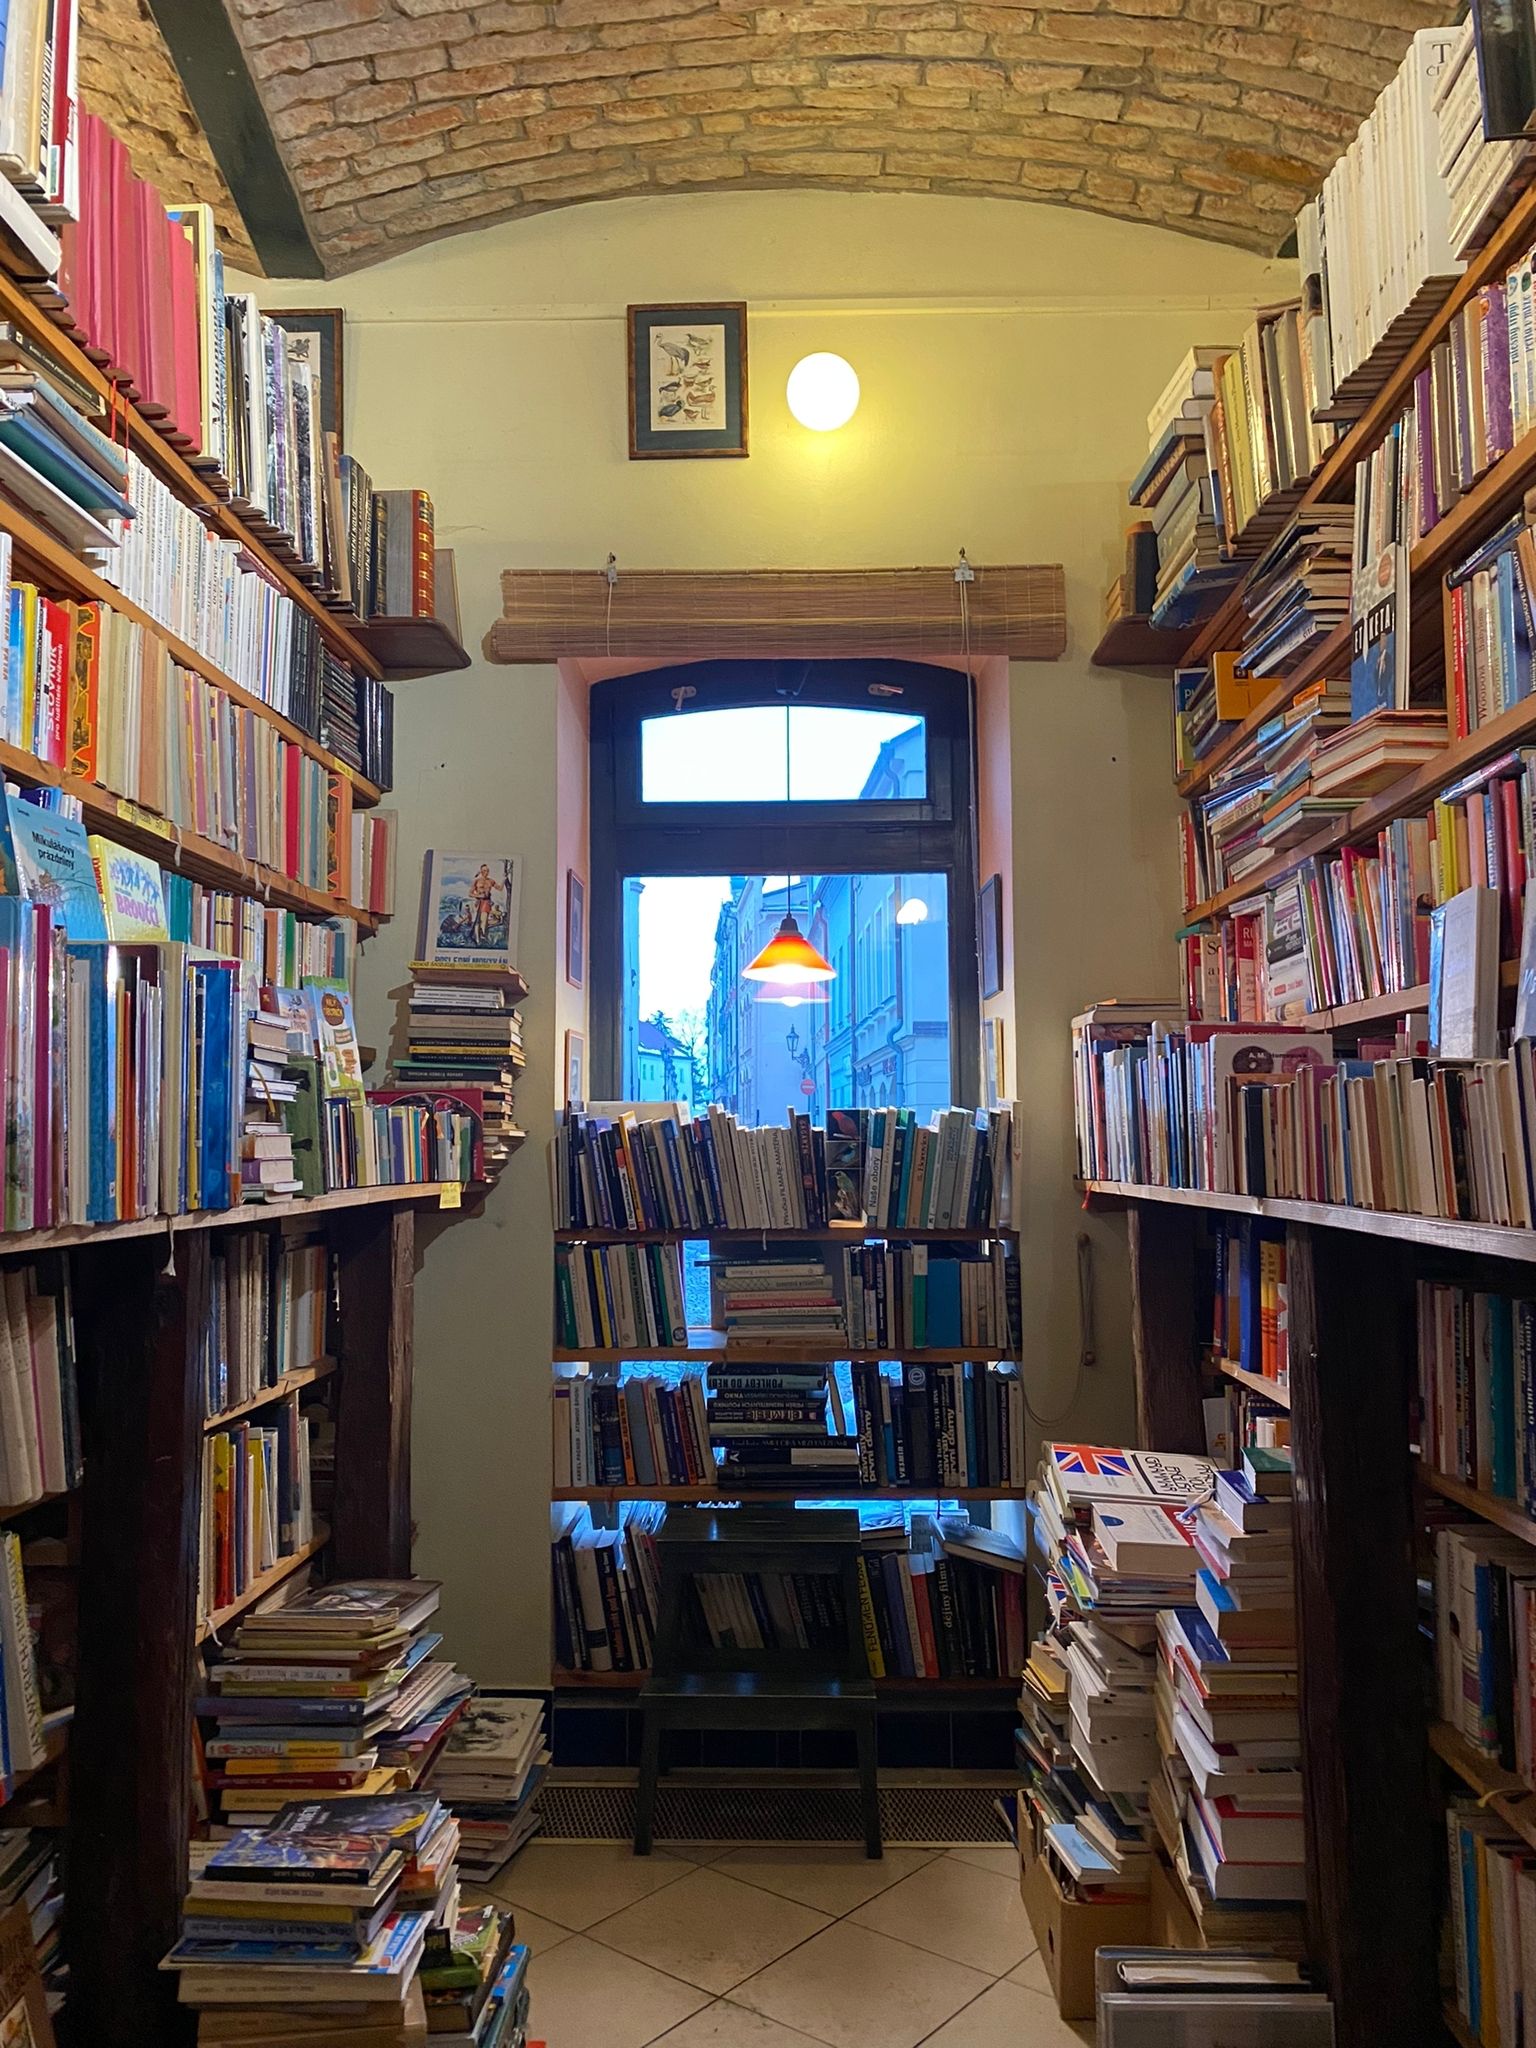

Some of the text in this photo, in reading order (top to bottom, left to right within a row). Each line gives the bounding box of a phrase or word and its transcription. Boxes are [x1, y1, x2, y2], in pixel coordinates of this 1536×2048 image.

[47, 645, 58, 732] SLOVNÍK
[31, 830, 76, 858] Mikulášovy
[37, 848, 76, 871] prázdniny
[115, 892, 159, 928] BROUČCI
[869, 1156, 881, 1208] Naše obory
[745, 1378, 784, 1389] POHLEDY
[938, 1562, 954, 1629] dějiny filmu
